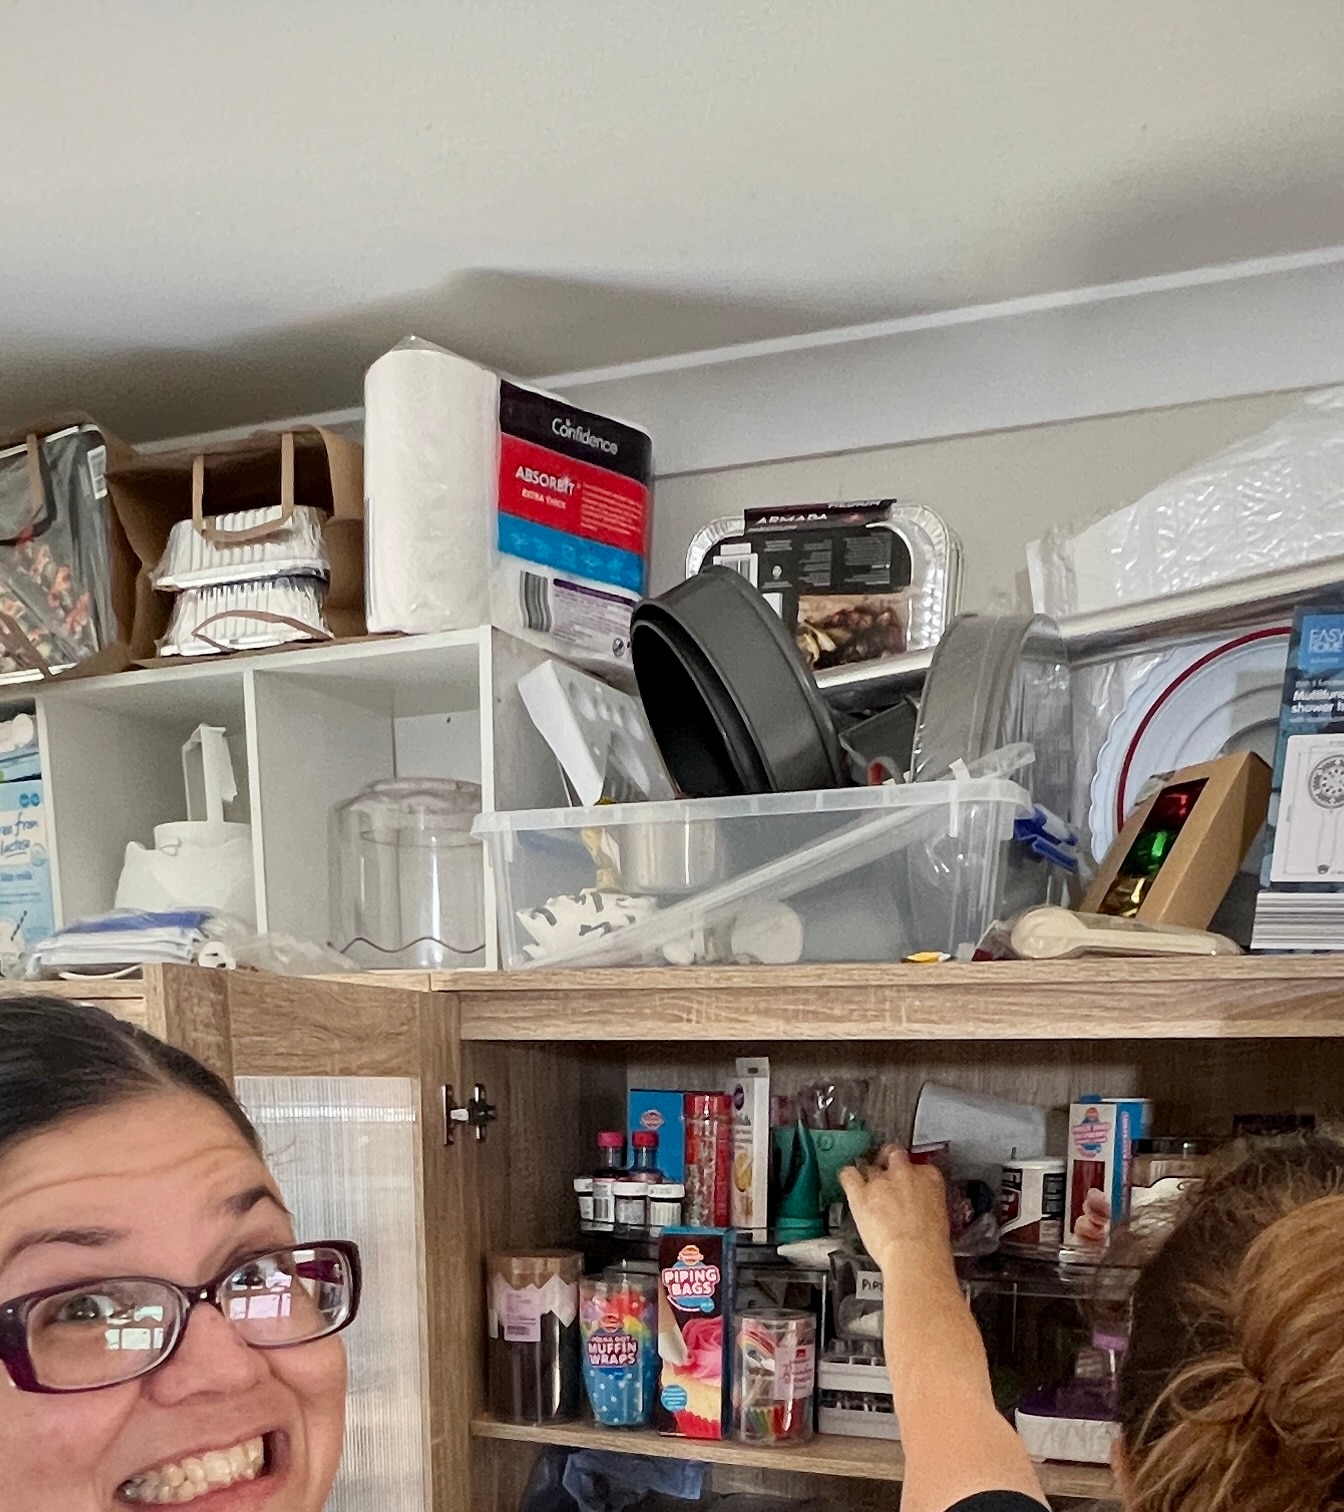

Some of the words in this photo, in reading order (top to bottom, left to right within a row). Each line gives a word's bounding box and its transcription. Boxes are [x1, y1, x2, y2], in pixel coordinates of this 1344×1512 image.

[552, 417, 618, 455] Confidence
[757, 512, 828, 524] ARMADA
[1291, 702, 1335, 714] shower
[664, 1268, 718, 1285] PIPING
[671, 1283, 712, 1296] BAGS
[588, 1341, 638, 1354] MUFFIN
[589, 1353, 636, 1366] WRAPS
